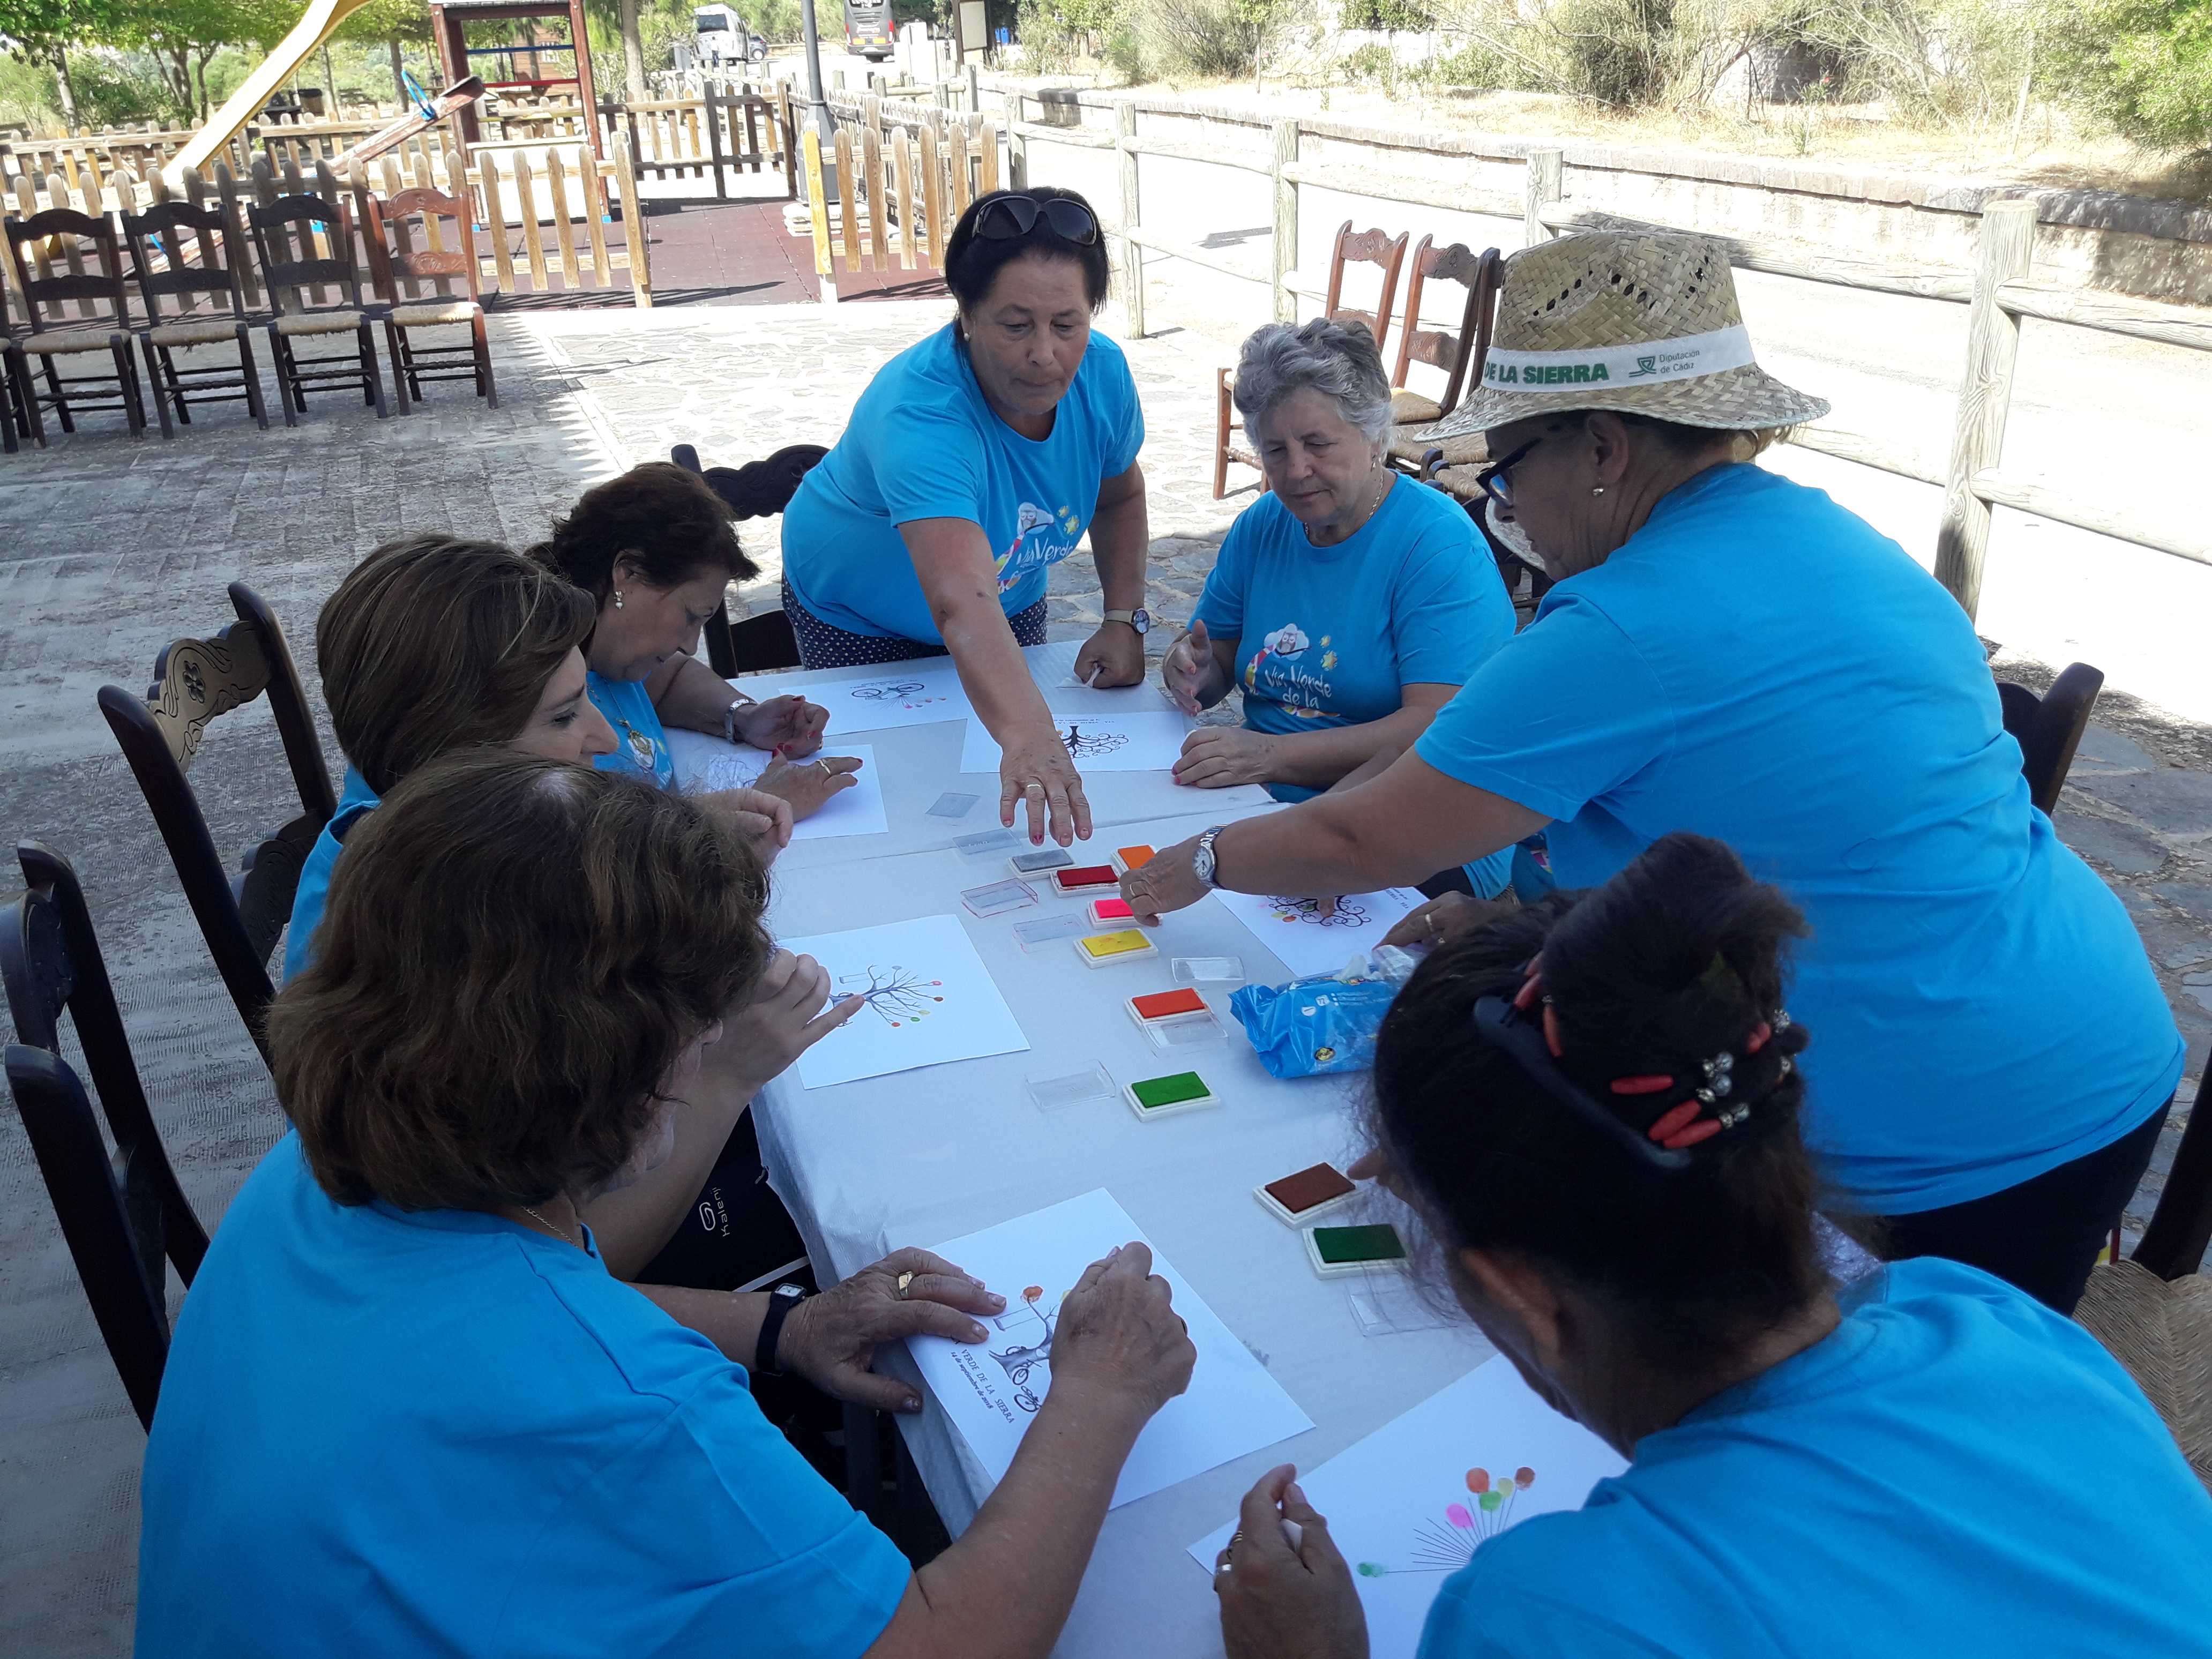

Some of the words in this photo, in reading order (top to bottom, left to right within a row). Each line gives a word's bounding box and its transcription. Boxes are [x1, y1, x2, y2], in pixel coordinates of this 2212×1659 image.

[1484, 361, 1497, 380] DE
[1498, 365, 1518, 383] LA
[1523, 363, 1609, 384] SIERRA
[1282, 687, 1300, 706] de
[1305, 689, 1319, 709] la
[1290, 664, 1332, 698] Verde
[709, 1187, 730, 1237] Kalenji
[959, 1364, 979, 1390] septiembre
[977, 1388, 984, 1396] de
[981, 1396, 993, 1409] 2018
[961, 1349, 980, 1371] VERDE
[976, 1372, 988, 1382] DE
[984, 1384, 996, 1395] LA
[995, 1399, 1015, 1423] SIERRA
